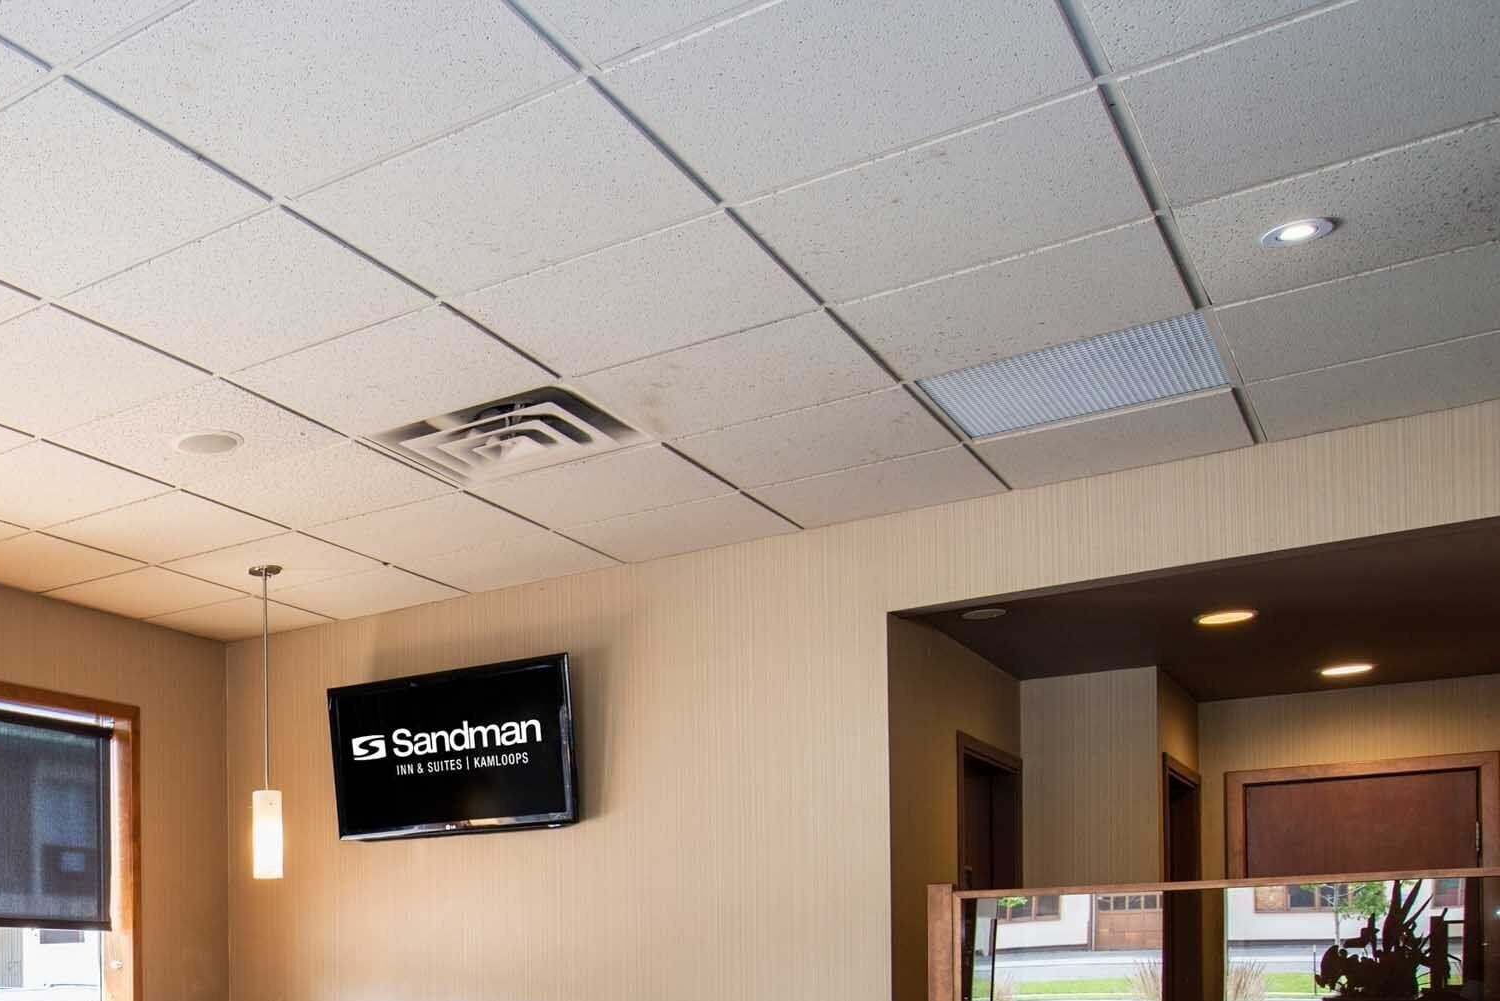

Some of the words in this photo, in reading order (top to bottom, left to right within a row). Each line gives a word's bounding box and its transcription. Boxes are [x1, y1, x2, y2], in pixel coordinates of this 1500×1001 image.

[392, 719, 542, 757] Sandman
[396, 763, 414, 776] INN
[417, 762, 425, 774] &
[427, 758, 463, 773] SUITES
[473, 752, 529, 769] KAMLOOPS
